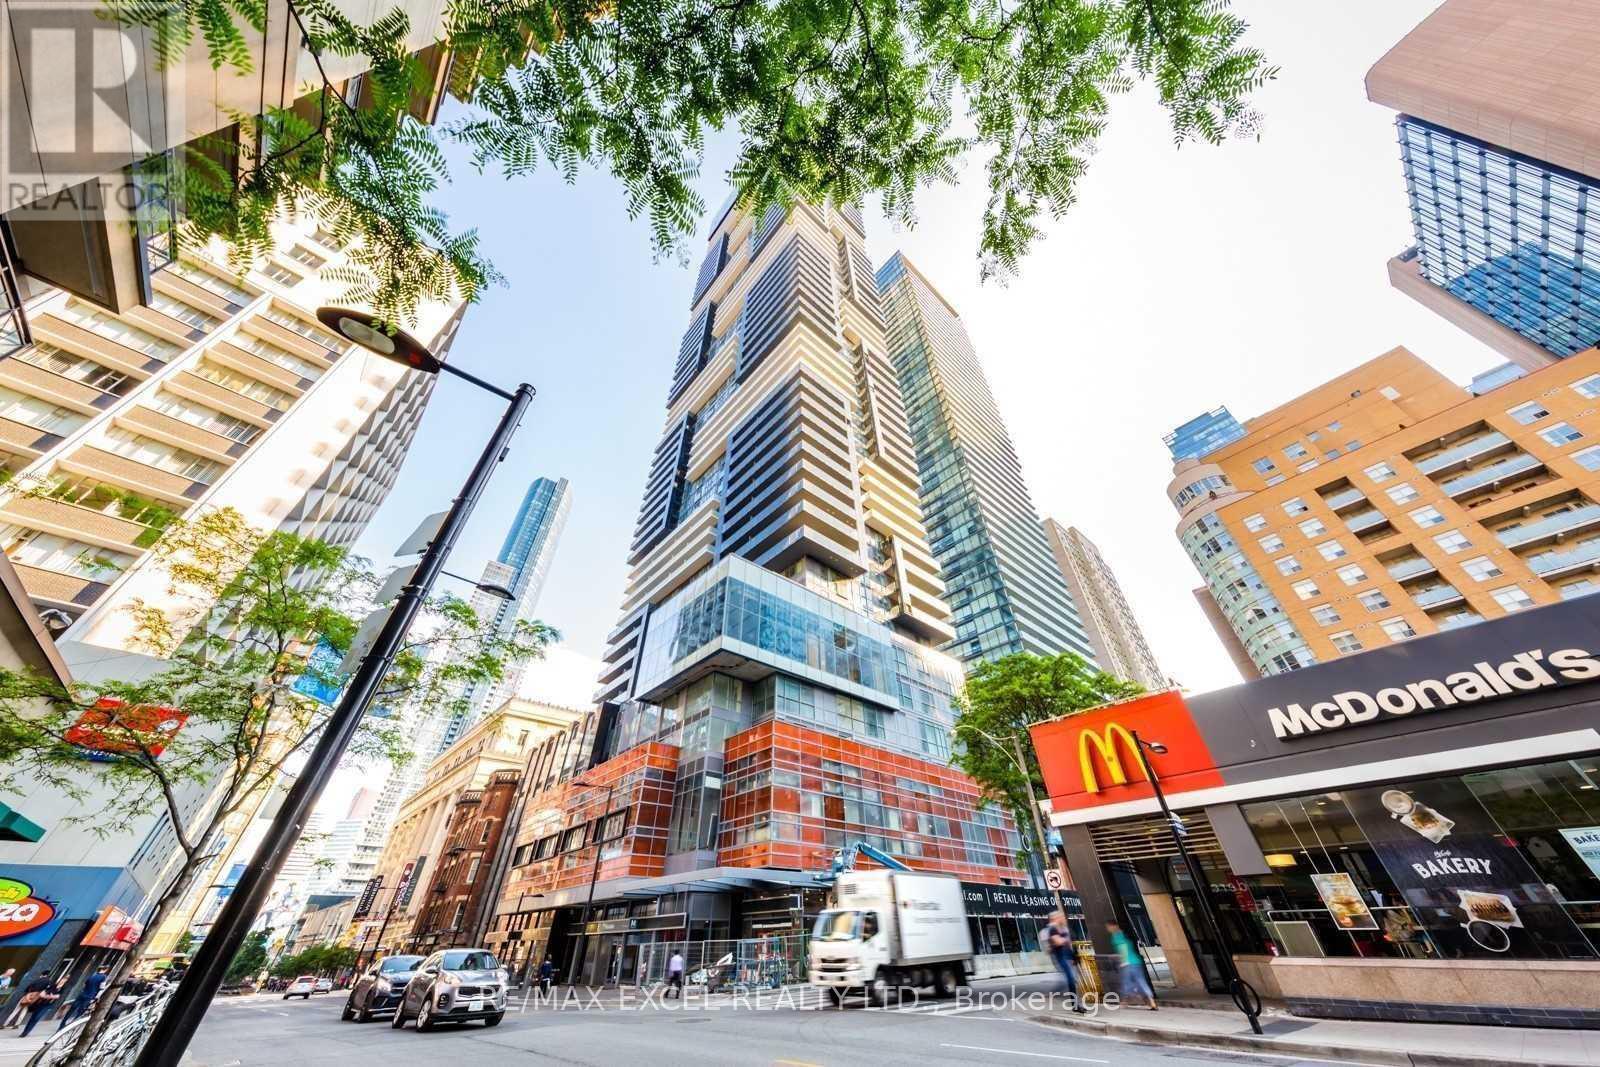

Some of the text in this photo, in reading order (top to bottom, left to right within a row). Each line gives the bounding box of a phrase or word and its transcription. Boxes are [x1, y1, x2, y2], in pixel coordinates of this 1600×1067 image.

[1267, 649, 1600, 738] McDonald's
[1411, 857, 1492, 879] BAKERY
[993, 892, 1018, 904] RETAIL
[1020, 895, 1049, 906] LEASING
